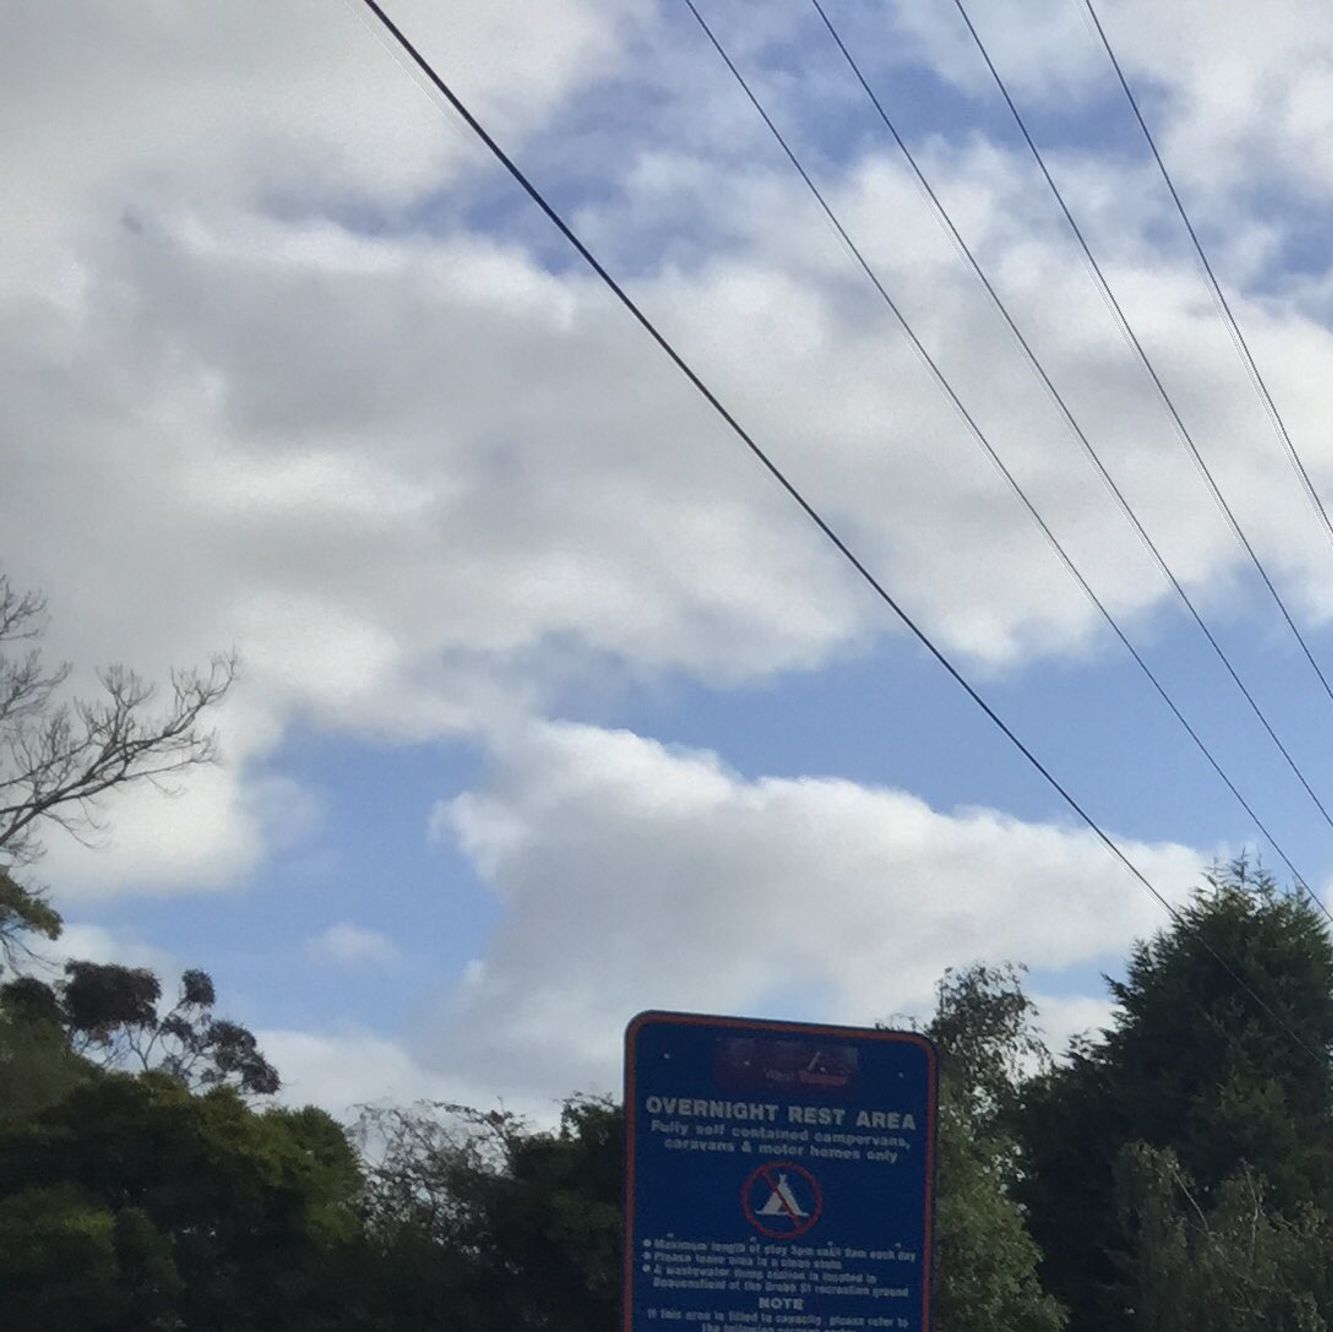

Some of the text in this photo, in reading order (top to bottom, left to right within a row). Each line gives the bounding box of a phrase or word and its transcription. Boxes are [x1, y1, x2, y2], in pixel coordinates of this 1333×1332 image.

[646, 1096, 917, 1130] OVERNIGHT REST AREA
[651, 1119, 911, 1150] Fully self contained campervans,
[663, 1138, 898, 1164] caravans & motor homes only
[759, 1297, 805, 1310] NOTE
